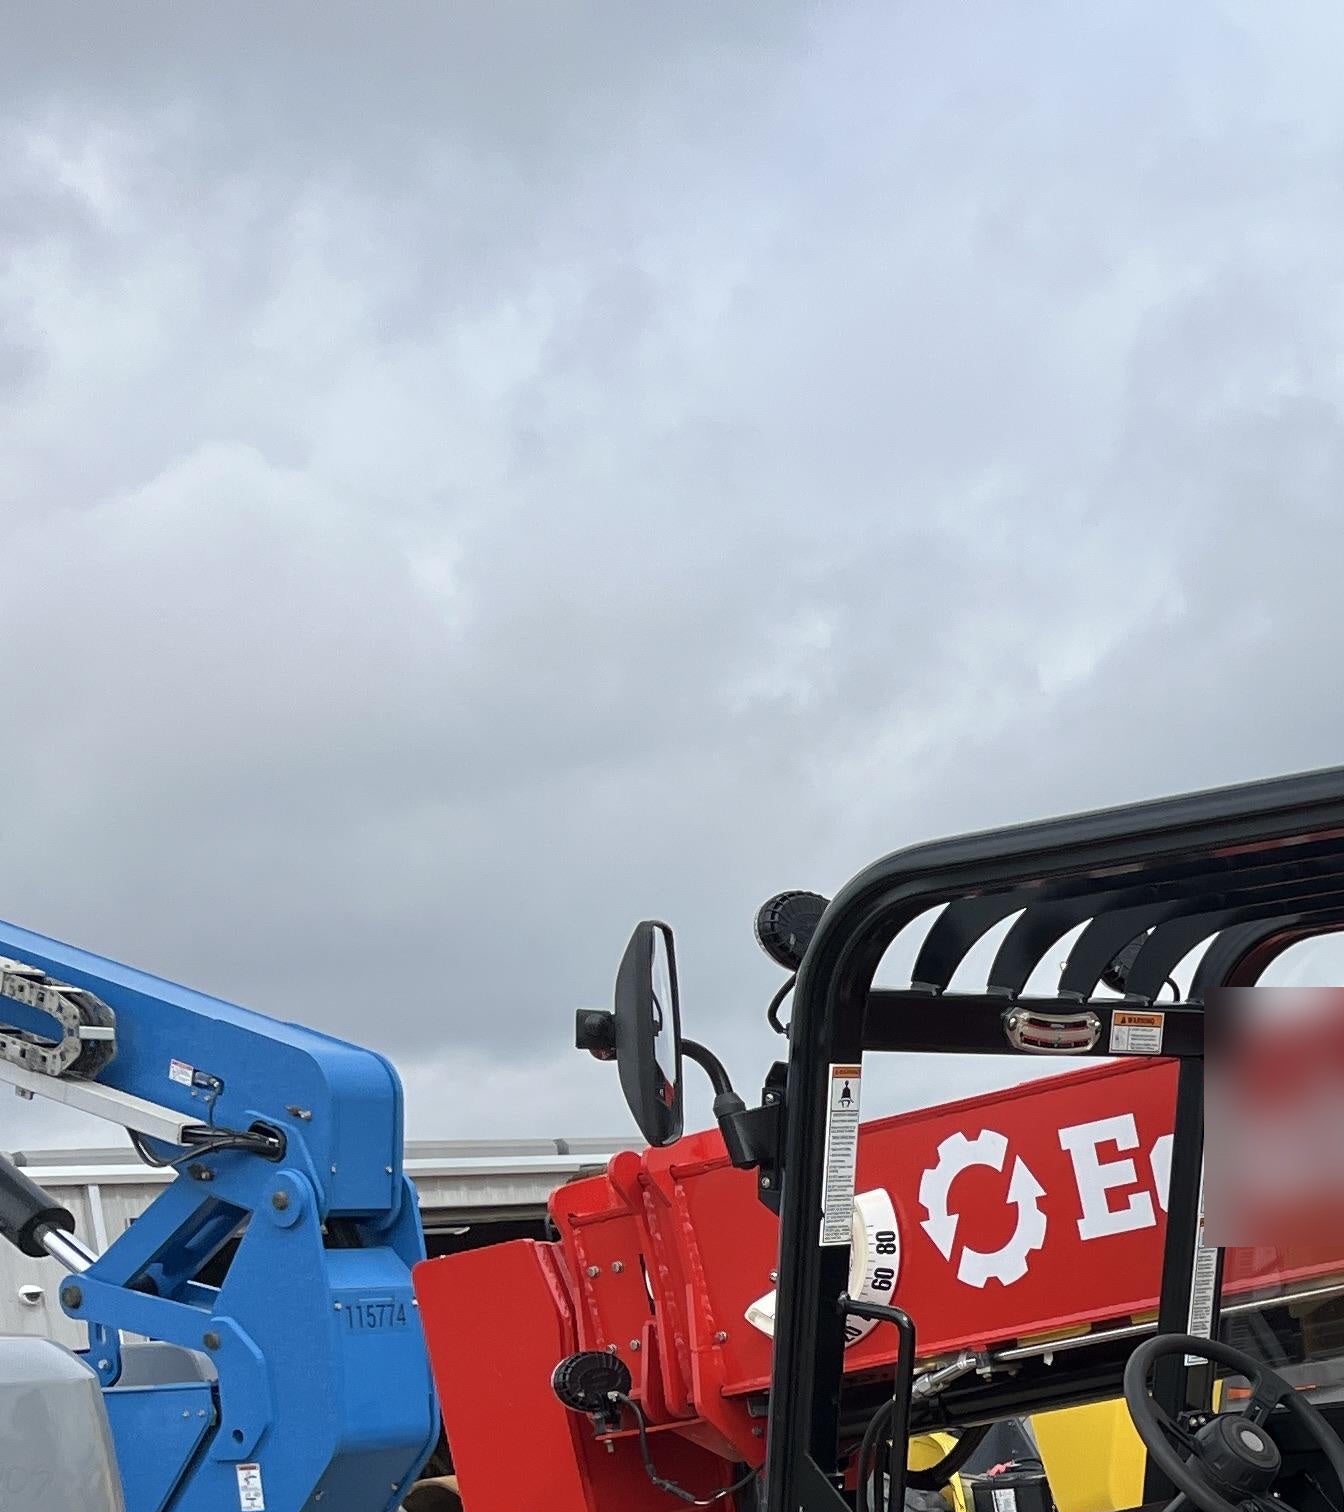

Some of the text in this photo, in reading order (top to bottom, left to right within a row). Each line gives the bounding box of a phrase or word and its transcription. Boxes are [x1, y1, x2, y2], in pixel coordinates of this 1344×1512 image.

[1058, 1113, 1175, 1241] E
[876, 1230, 897, 1255] 80
[871, 1267, 895, 1291] 60
[346, 1303, 407, 1329] 115774
